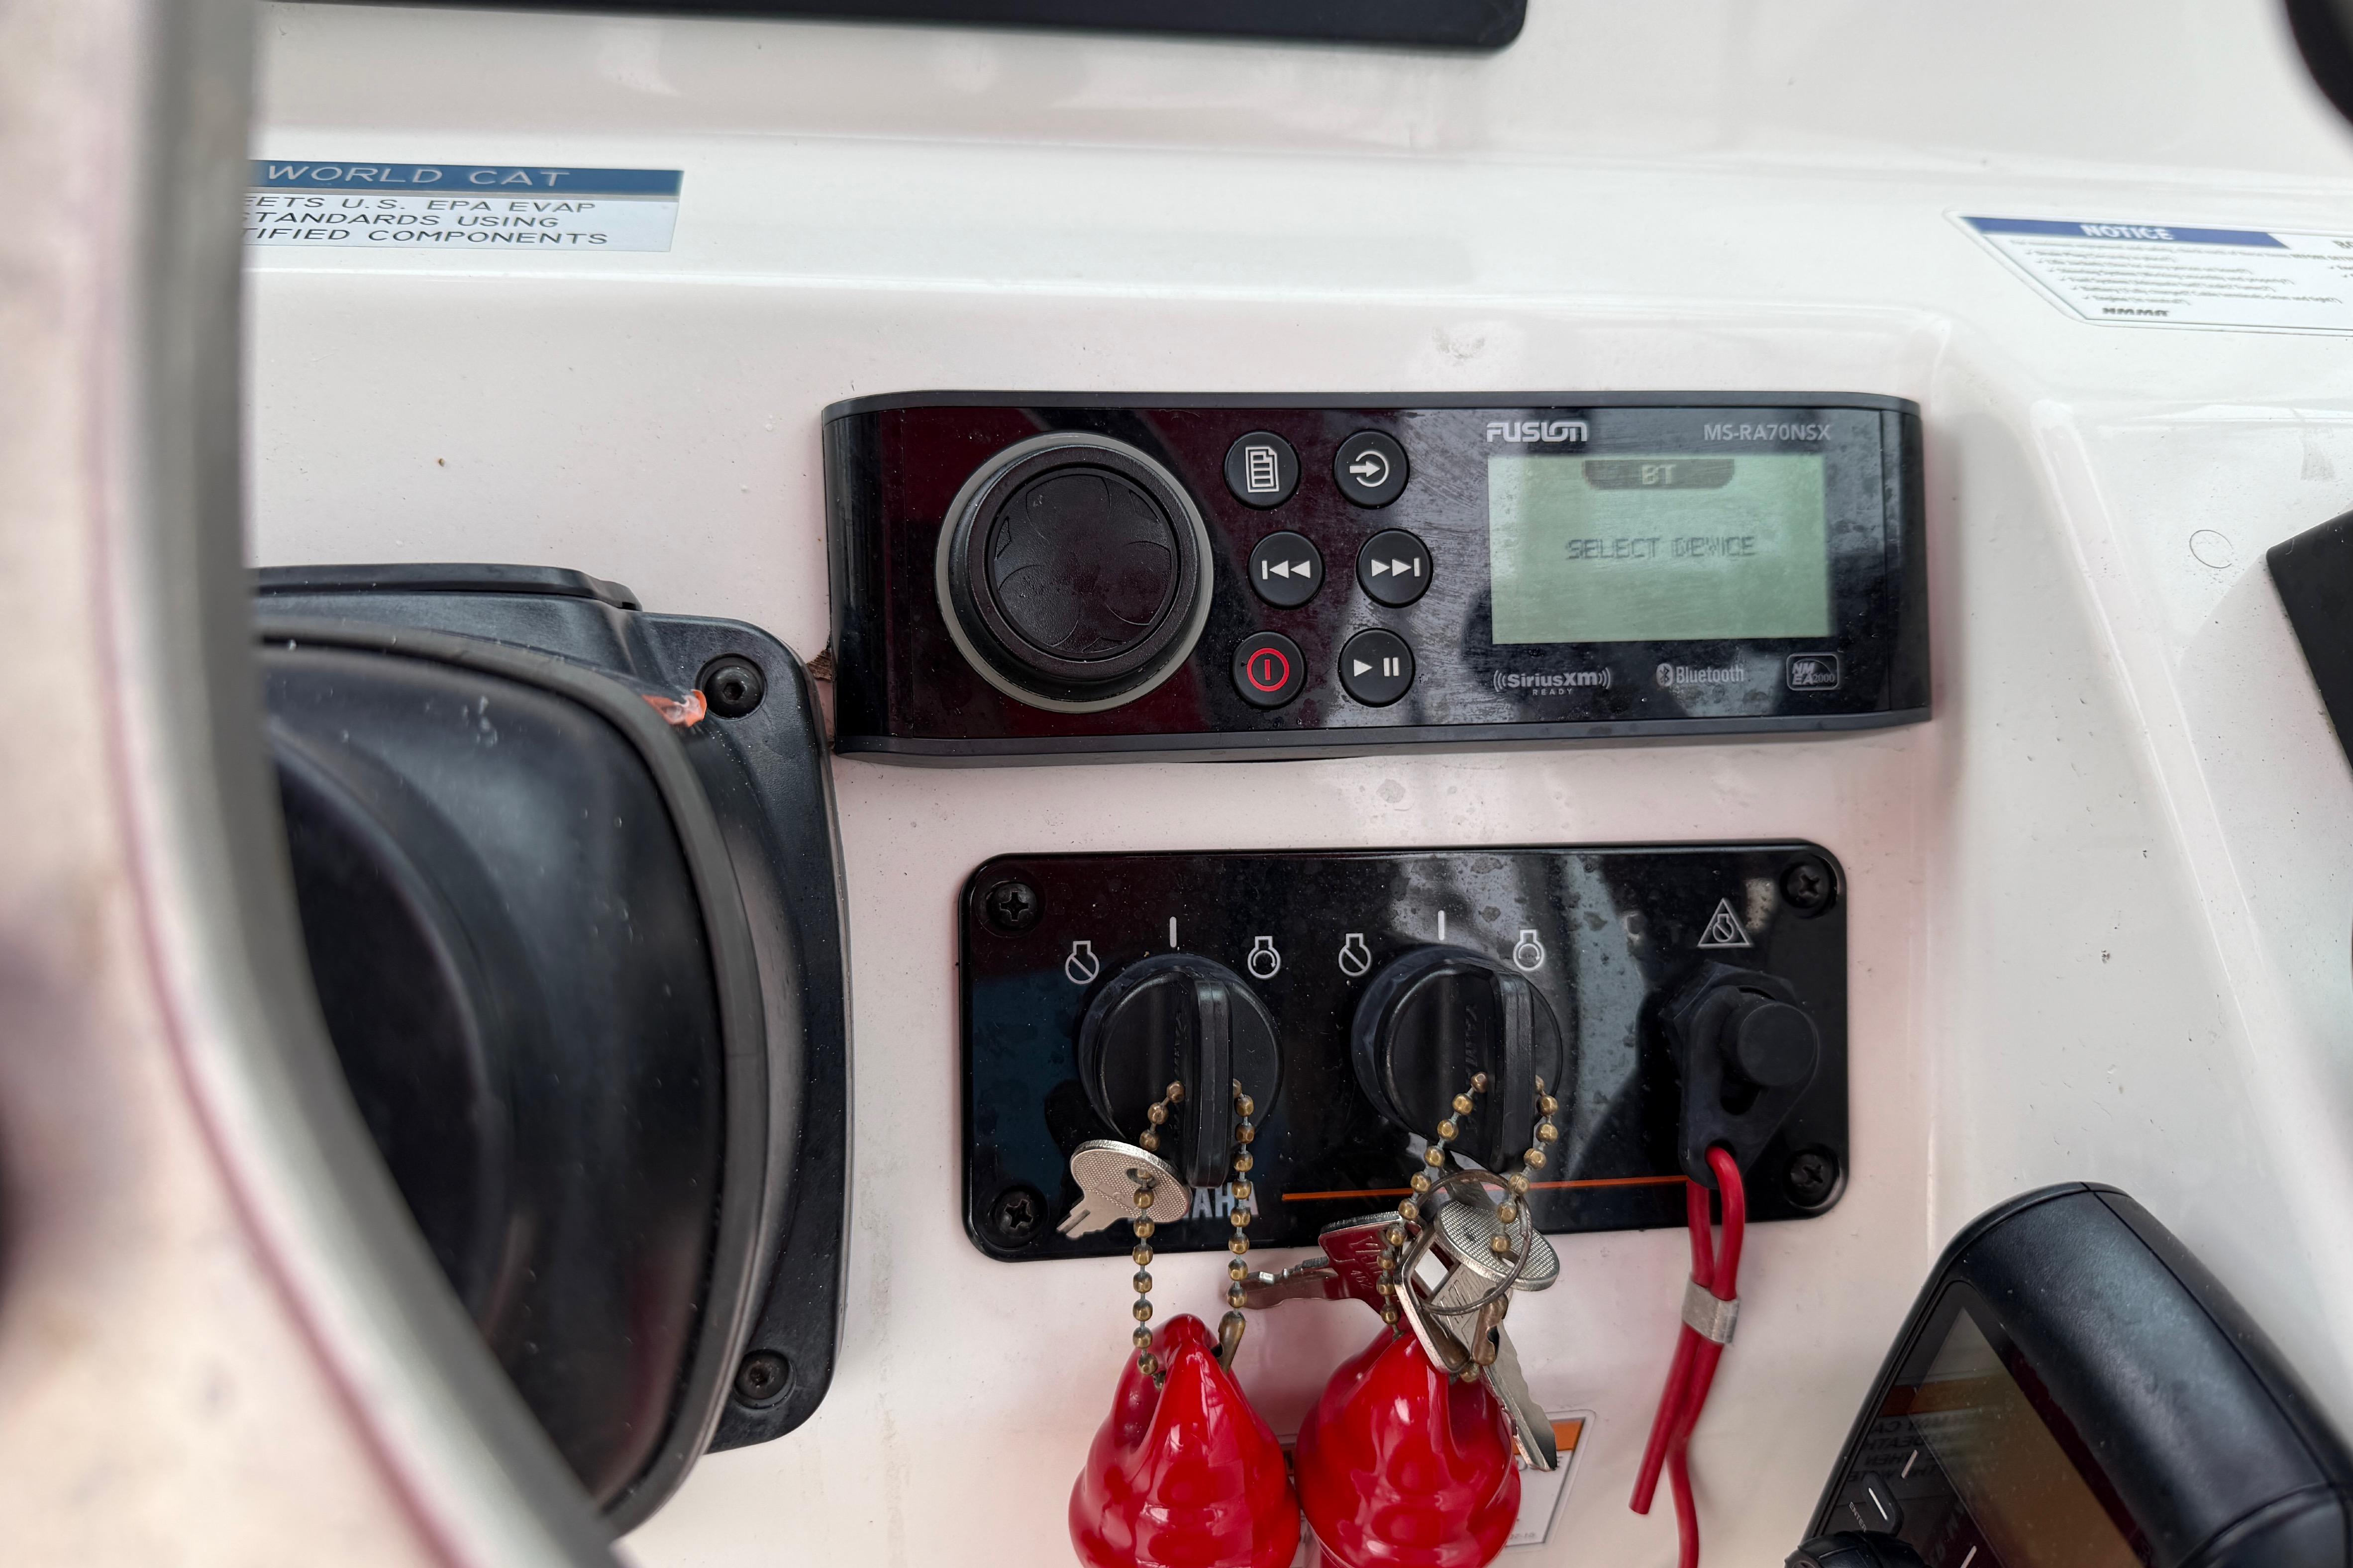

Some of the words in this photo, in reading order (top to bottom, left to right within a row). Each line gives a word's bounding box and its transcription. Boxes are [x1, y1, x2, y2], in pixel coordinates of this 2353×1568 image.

[269, 165, 442, 183] WORLD
[469, 170, 570, 187] CAT
[342, 198, 406, 209] U.S.
[427, 200, 492, 211] EPA
[509, 202, 596, 213] EVAP
[457, 216, 559, 228] USING
[2079, 224, 2175, 240] NOTICE
[368, 230, 609, 244] COMPONENTS
[1486, 422, 1588, 442] FUSION
[1704, 424, 1832, 441] MS-RA70NSX
[1642, 464, 1676, 485] BT
[1566, 537, 1660, 559] SELECT
[1671, 536, 1757, 558] DEVICE
[1676, 663, 1743, 684] Bluetooth
[1849, 1501, 1866, 1533] ENTER
